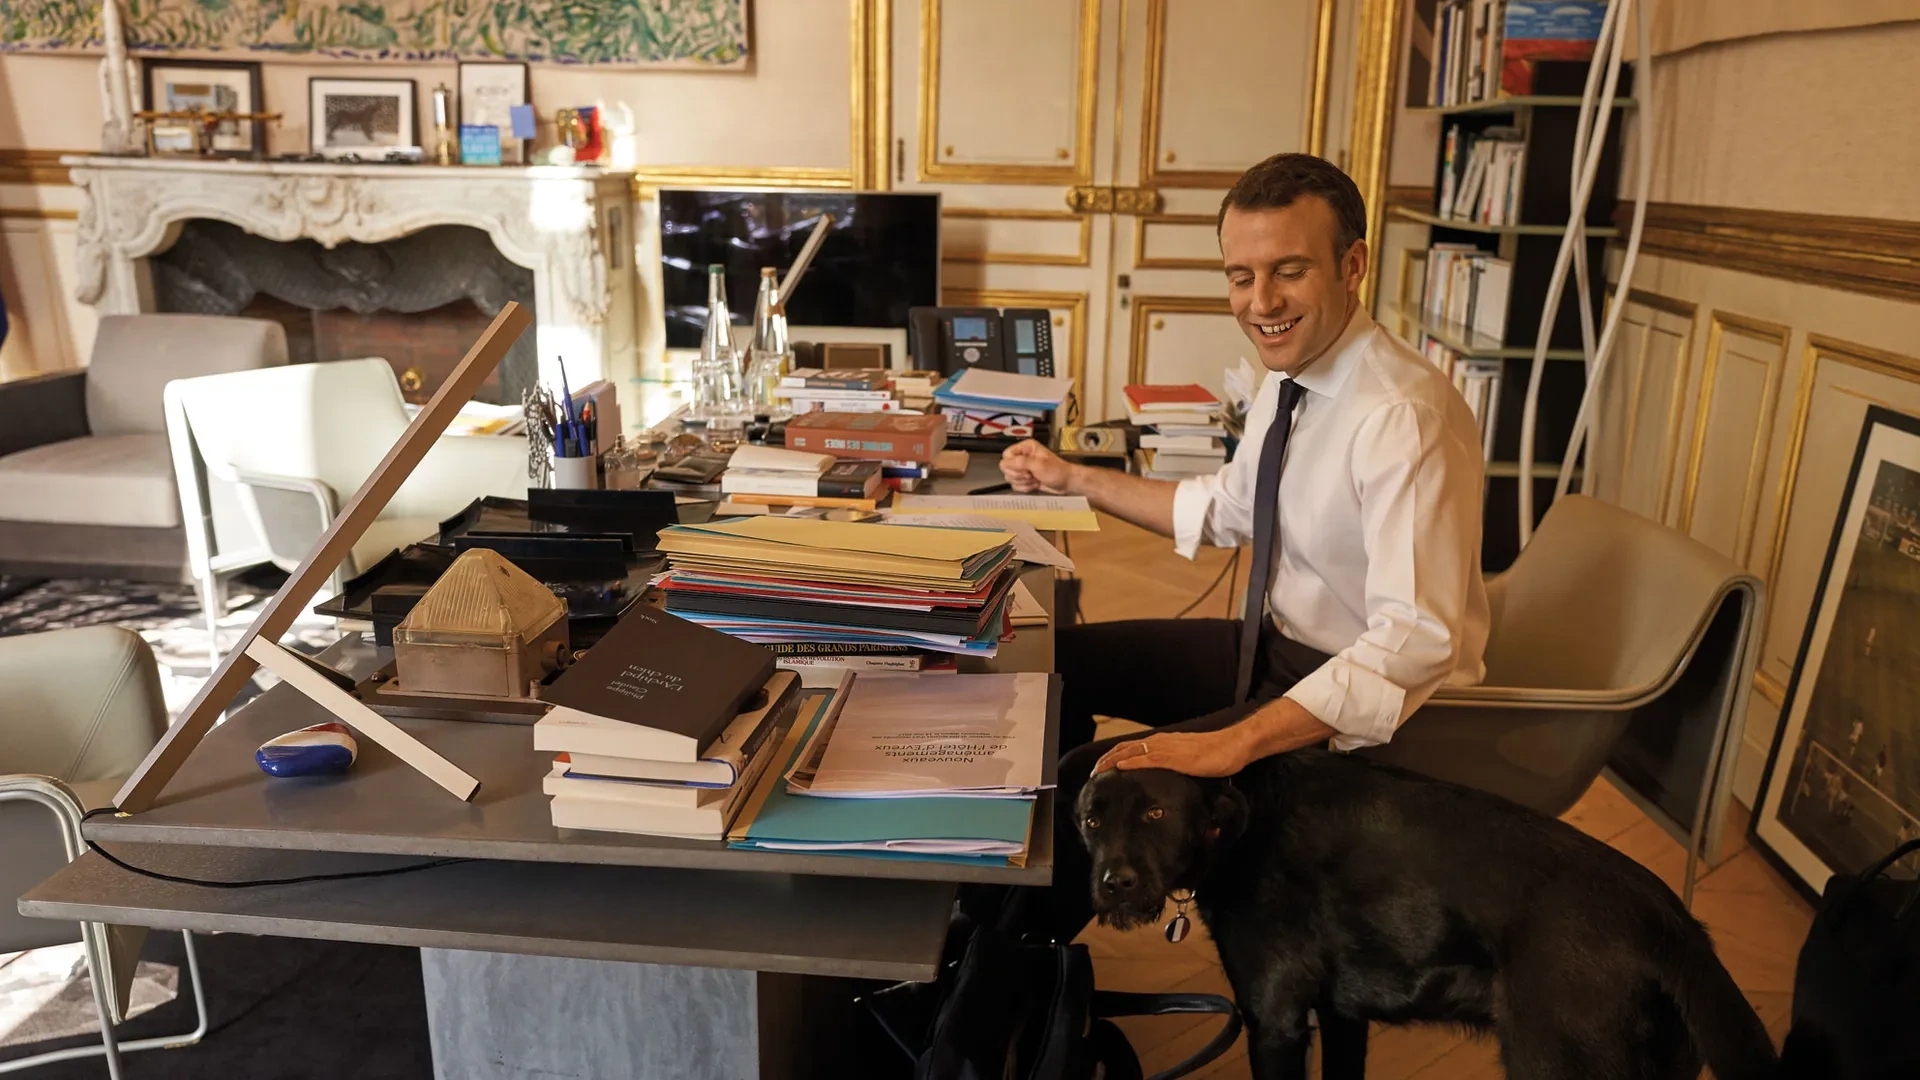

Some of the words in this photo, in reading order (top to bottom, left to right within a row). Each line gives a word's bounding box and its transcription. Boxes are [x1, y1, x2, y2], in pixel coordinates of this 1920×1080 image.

[796, 644, 815, 653] DES
[818, 644, 858, 652] GRANDS
[859, 644, 908, 652] PARISIENS
[628, 664, 662, 678] chien
[665, 674, 682, 682] du
[610, 680, 648, 694] Claudel
[620, 670, 684, 692] L'Archipel
[606, 686, 645, 700] Philippe
